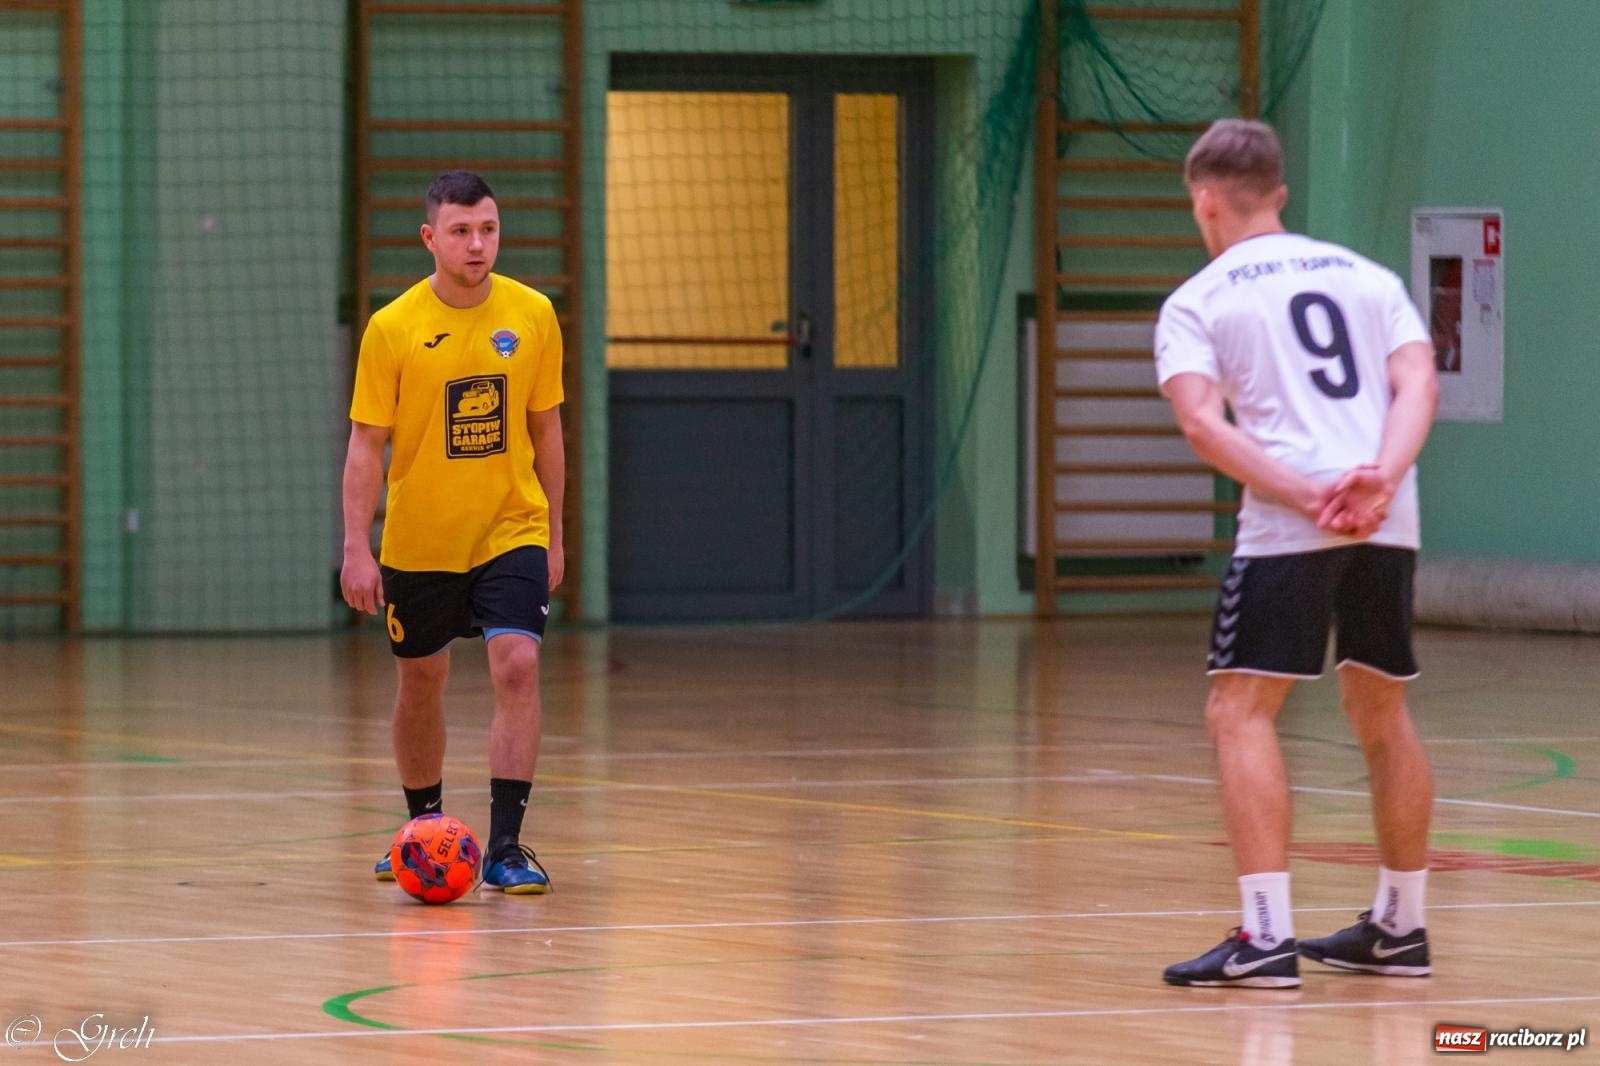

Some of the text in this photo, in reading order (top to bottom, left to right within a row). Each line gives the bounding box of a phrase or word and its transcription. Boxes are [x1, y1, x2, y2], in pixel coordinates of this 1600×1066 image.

[1289, 290, 1360, 400] 9
[452, 419, 501, 435] STOPIW
[452, 431, 501, 447] GARAGE
[386, 602, 405, 643] 6
